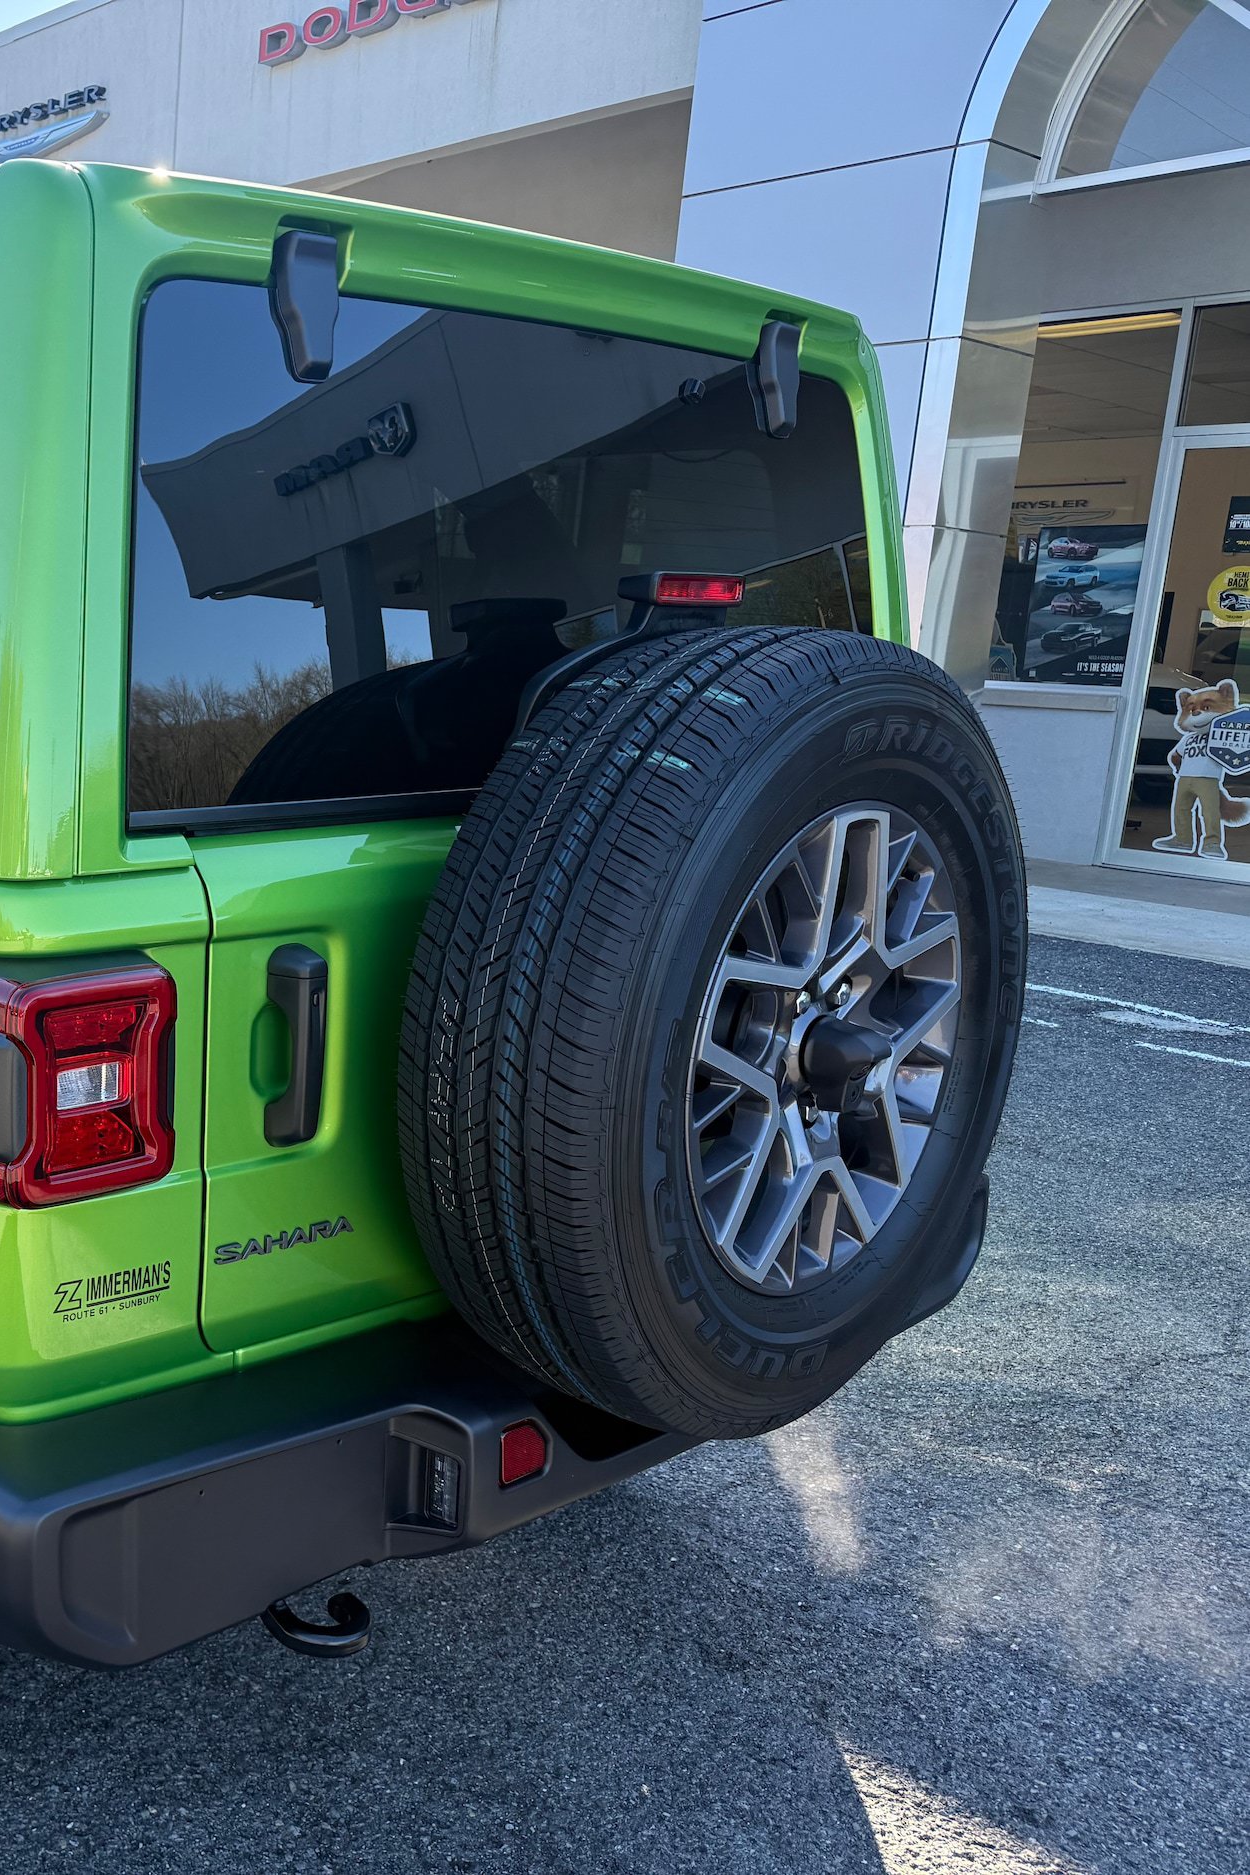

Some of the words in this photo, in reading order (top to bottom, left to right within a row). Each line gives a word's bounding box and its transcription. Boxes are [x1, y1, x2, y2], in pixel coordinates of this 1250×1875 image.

[258, 0, 458, 67] DOD
[1227, 577, 1250, 588] BACK
[1076, 662, 1089, 671] IT'S
[1089, 662, 1100, 672] THE
[1101, 663, 1124, 673] SEASON
[1183, 745, 1206, 759] FOX
[839, 714, 1022, 1024] BRIDGESTONE
[214, 1216, 354, 1265] SAHARA
[62, 1307, 96, 1323] ROUTE
[98, 1305, 109, 1315] 61
[118, 1293, 161, 1311] SUNBURY
